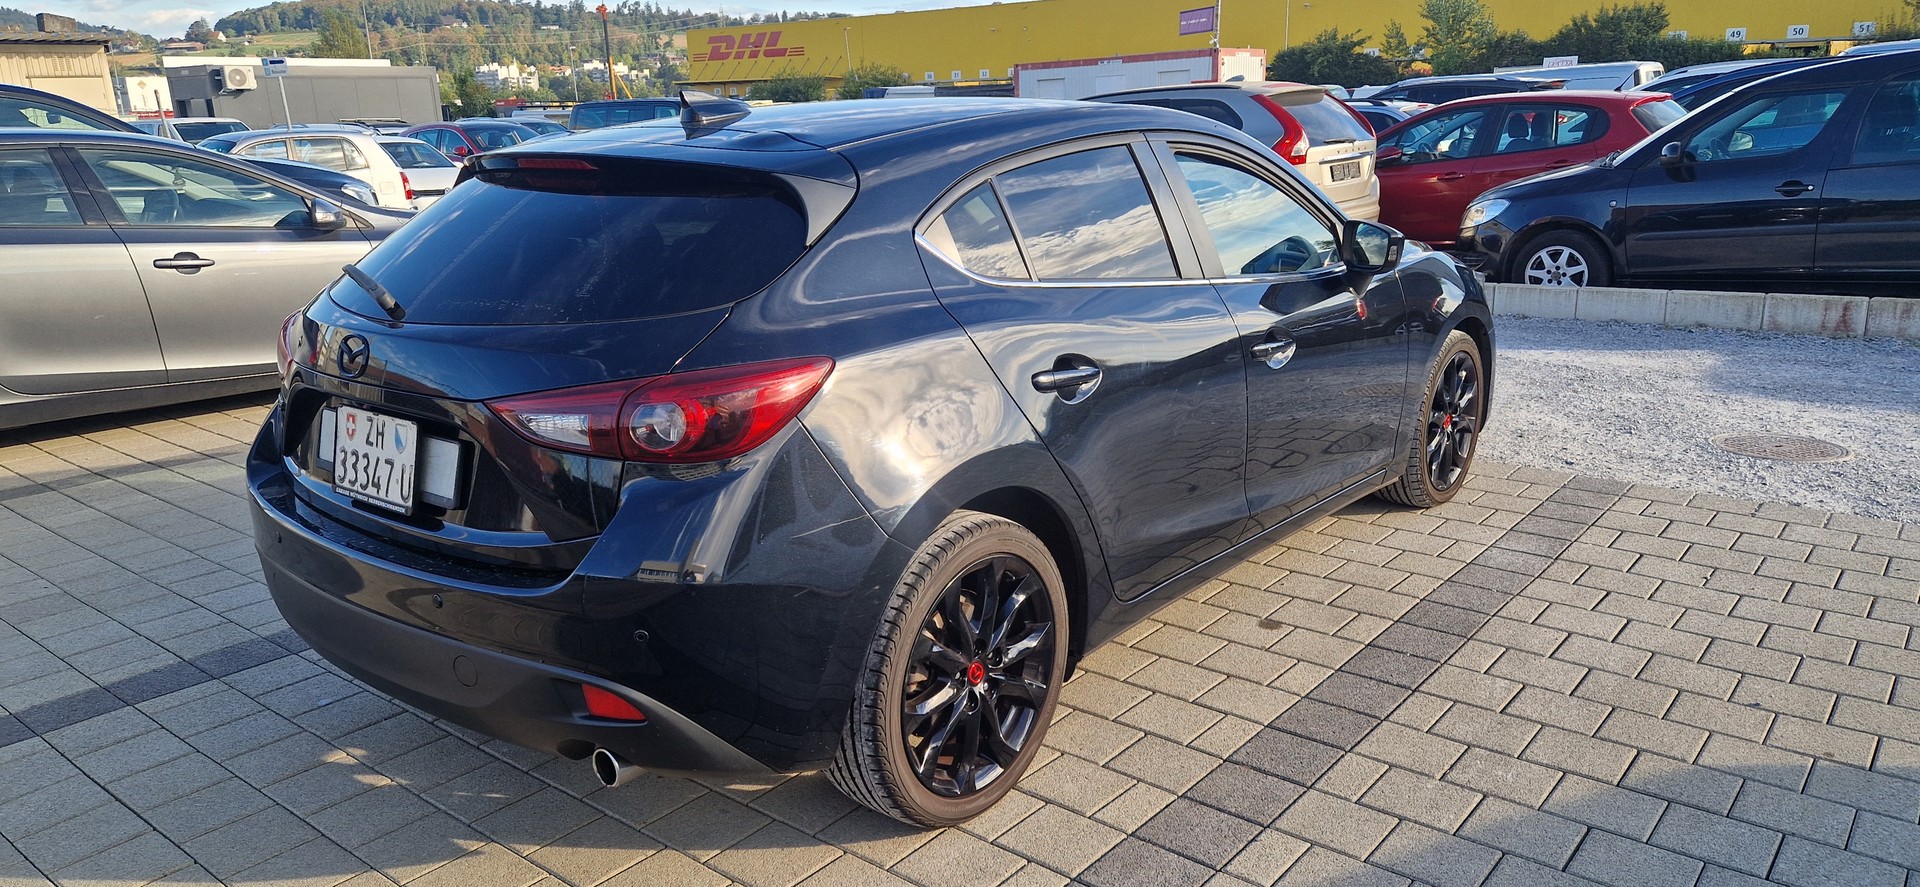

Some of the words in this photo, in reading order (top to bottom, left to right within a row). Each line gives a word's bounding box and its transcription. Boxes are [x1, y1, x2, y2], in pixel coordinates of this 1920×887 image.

[1792, 27, 1804, 36] 50
[1858, 24, 1871, 33] 51
[1729, 30, 1742, 39] 49
[707, 31, 789, 62] DHL
[365, 415, 386, 451] ZH
